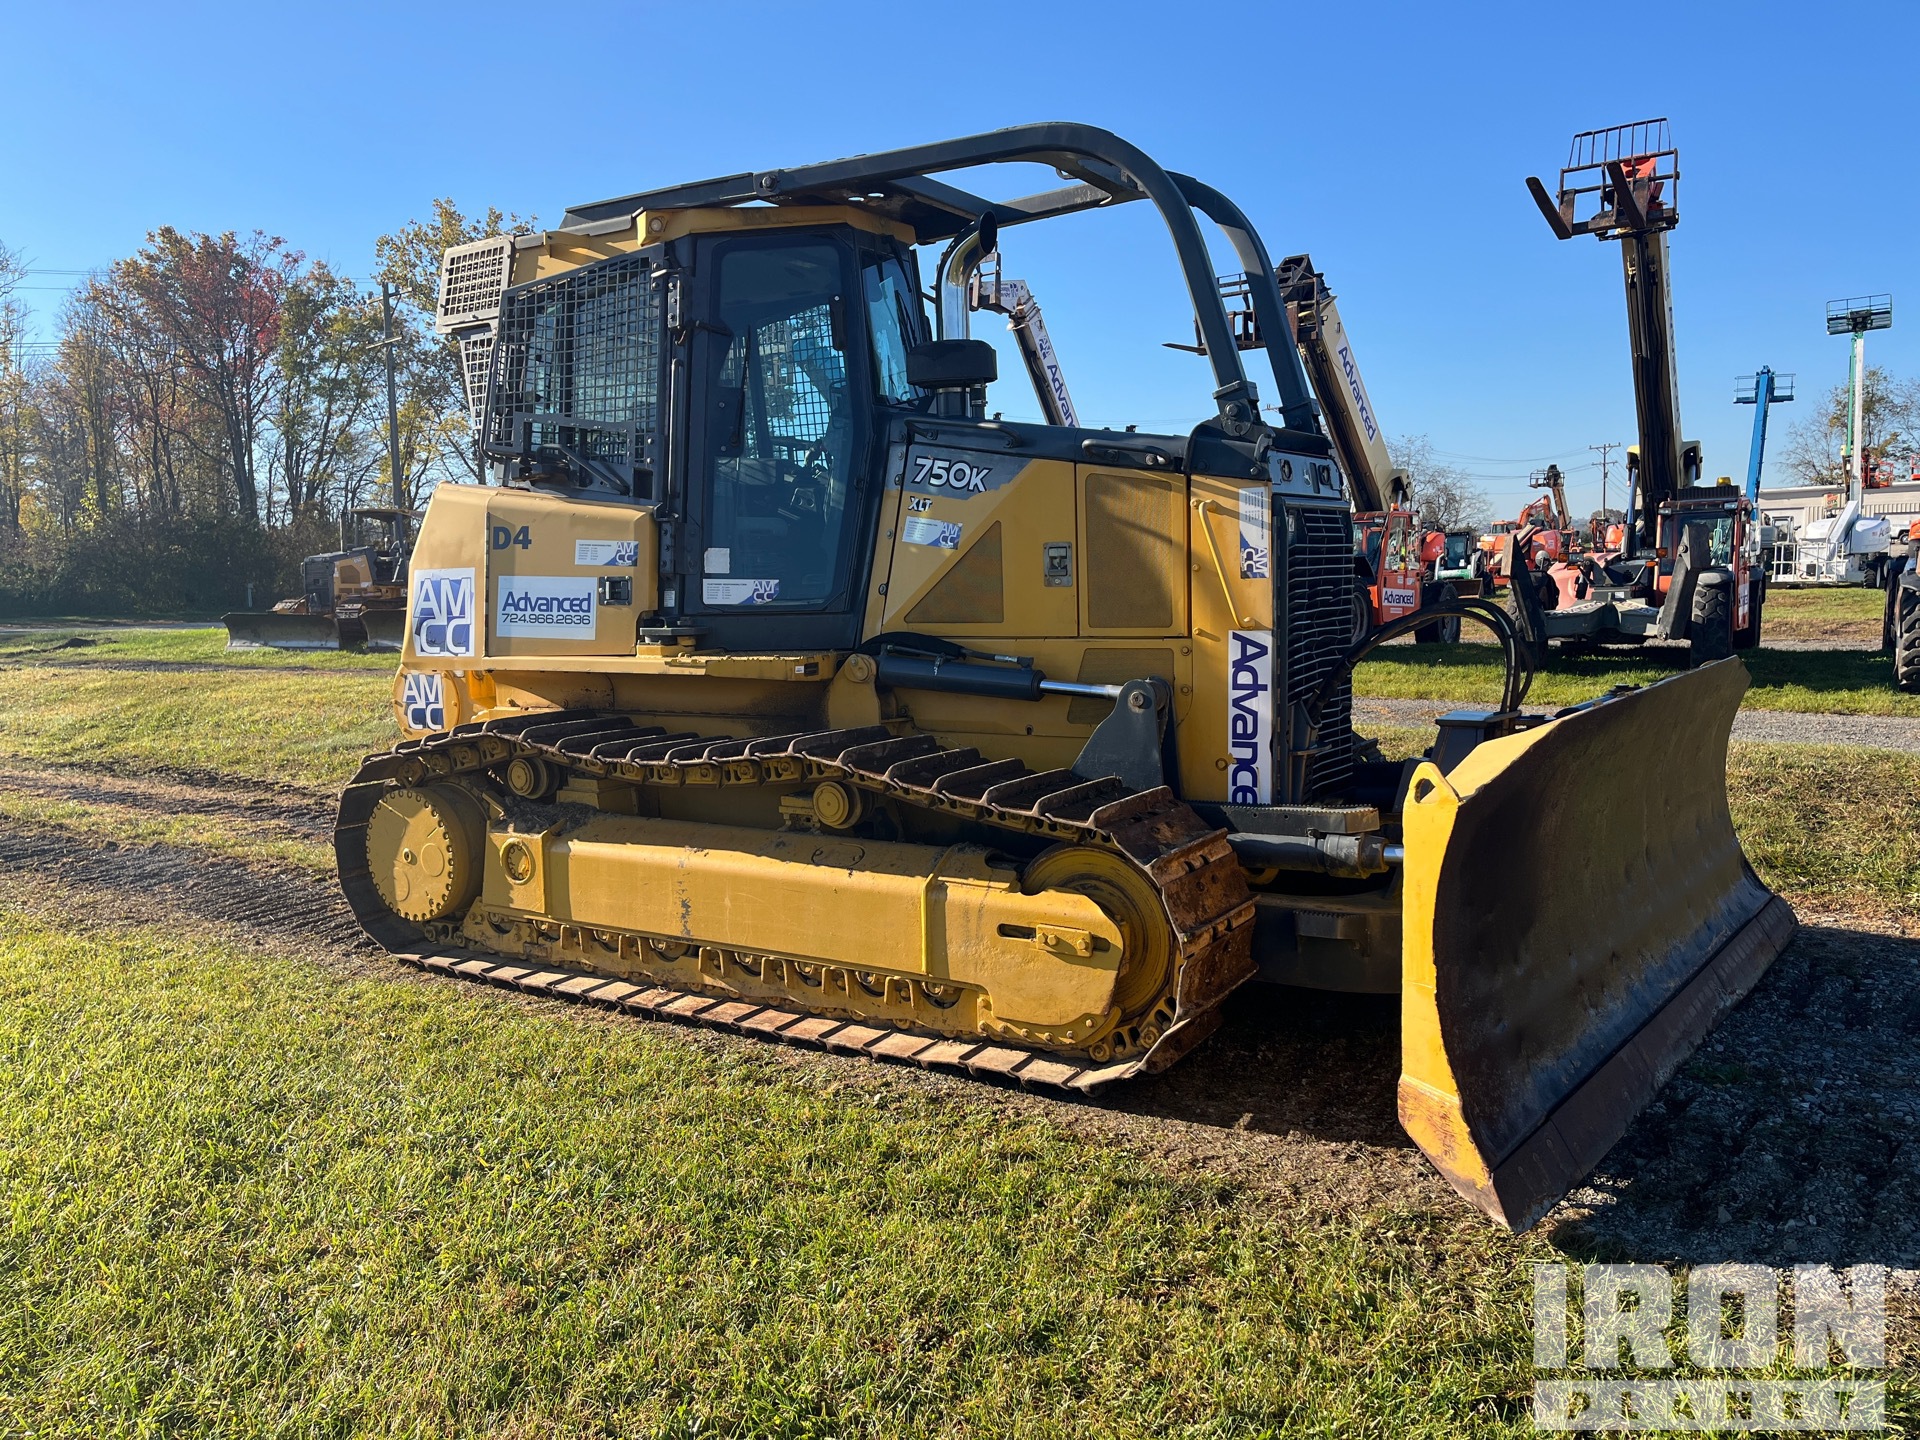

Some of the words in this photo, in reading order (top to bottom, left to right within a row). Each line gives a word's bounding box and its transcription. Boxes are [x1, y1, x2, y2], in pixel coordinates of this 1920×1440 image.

[1338, 346, 1377, 442] Advanced
[911, 455, 993, 493] 750K
[908, 495, 933, 513] XLT
[492, 525, 532, 550] D4
[415, 577, 472, 615] AM
[502, 591, 592, 613] Advanced
[1384, 591, 1413, 604] Advanced
[502, 612, 591, 625] 724.966.2636
[402, 674, 443, 703] AM
